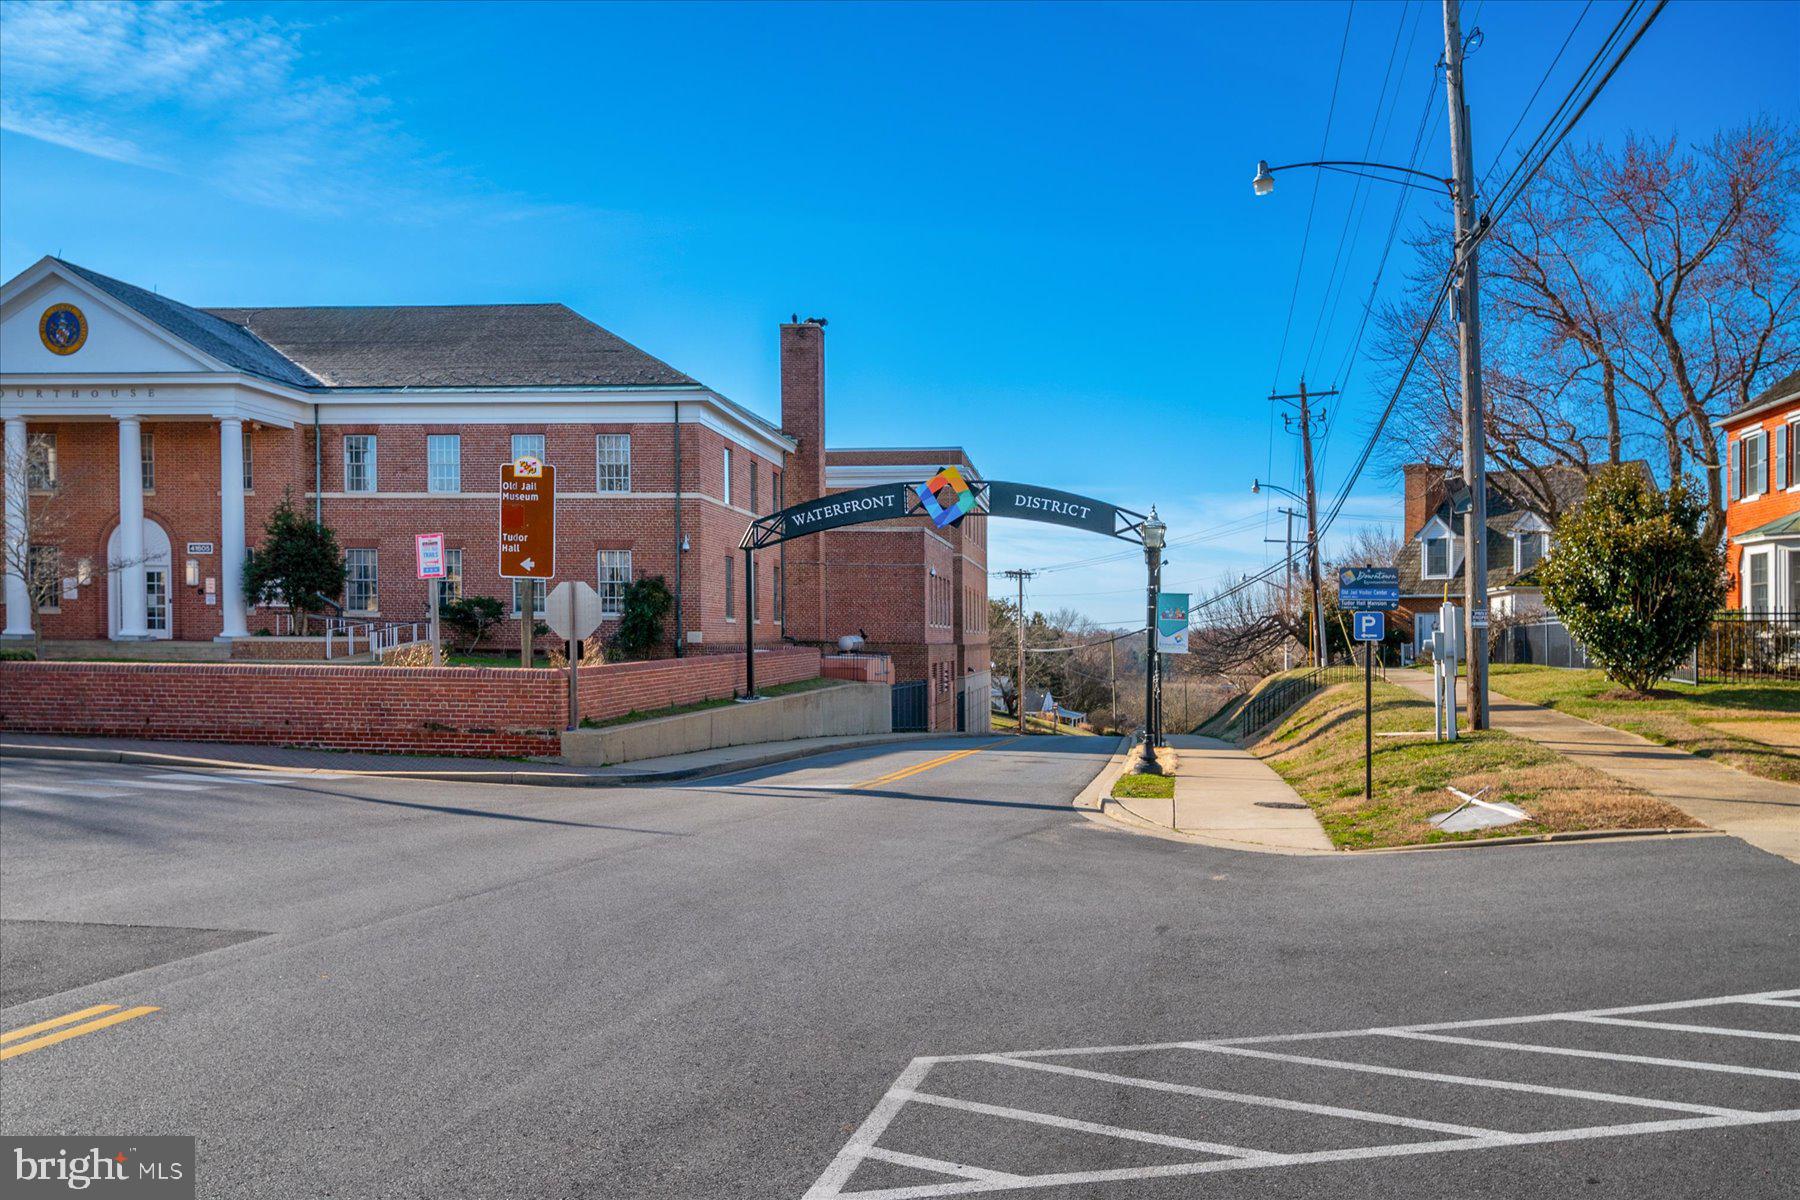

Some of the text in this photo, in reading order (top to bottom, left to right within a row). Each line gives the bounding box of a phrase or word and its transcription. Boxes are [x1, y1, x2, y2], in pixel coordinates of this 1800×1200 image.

[502, 482, 537, 490] Old Jail
[502, 492, 539, 500] Museum
[792, 494, 1091, 526] WATERFRONT DISTRICT
[502, 533, 528, 541] Tudor
[501, 544, 520, 552] Hall
[1356, 571, 1397, 581] Downtown
[1361, 616, 1376, 632] P
